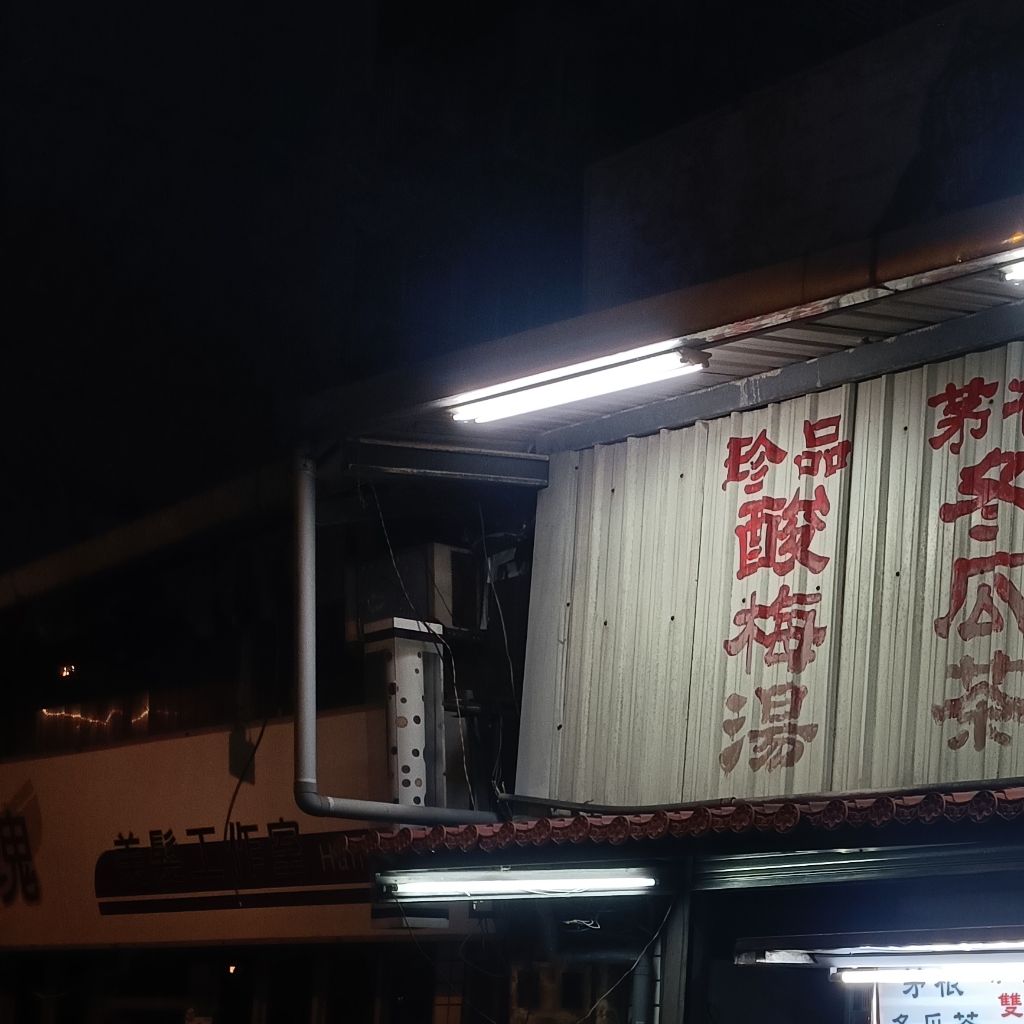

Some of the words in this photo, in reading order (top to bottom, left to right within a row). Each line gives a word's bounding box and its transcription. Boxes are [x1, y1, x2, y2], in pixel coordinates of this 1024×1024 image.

[721, 413, 851, 496] 珍品
[718, 484, 831, 775] 酸梅湯
